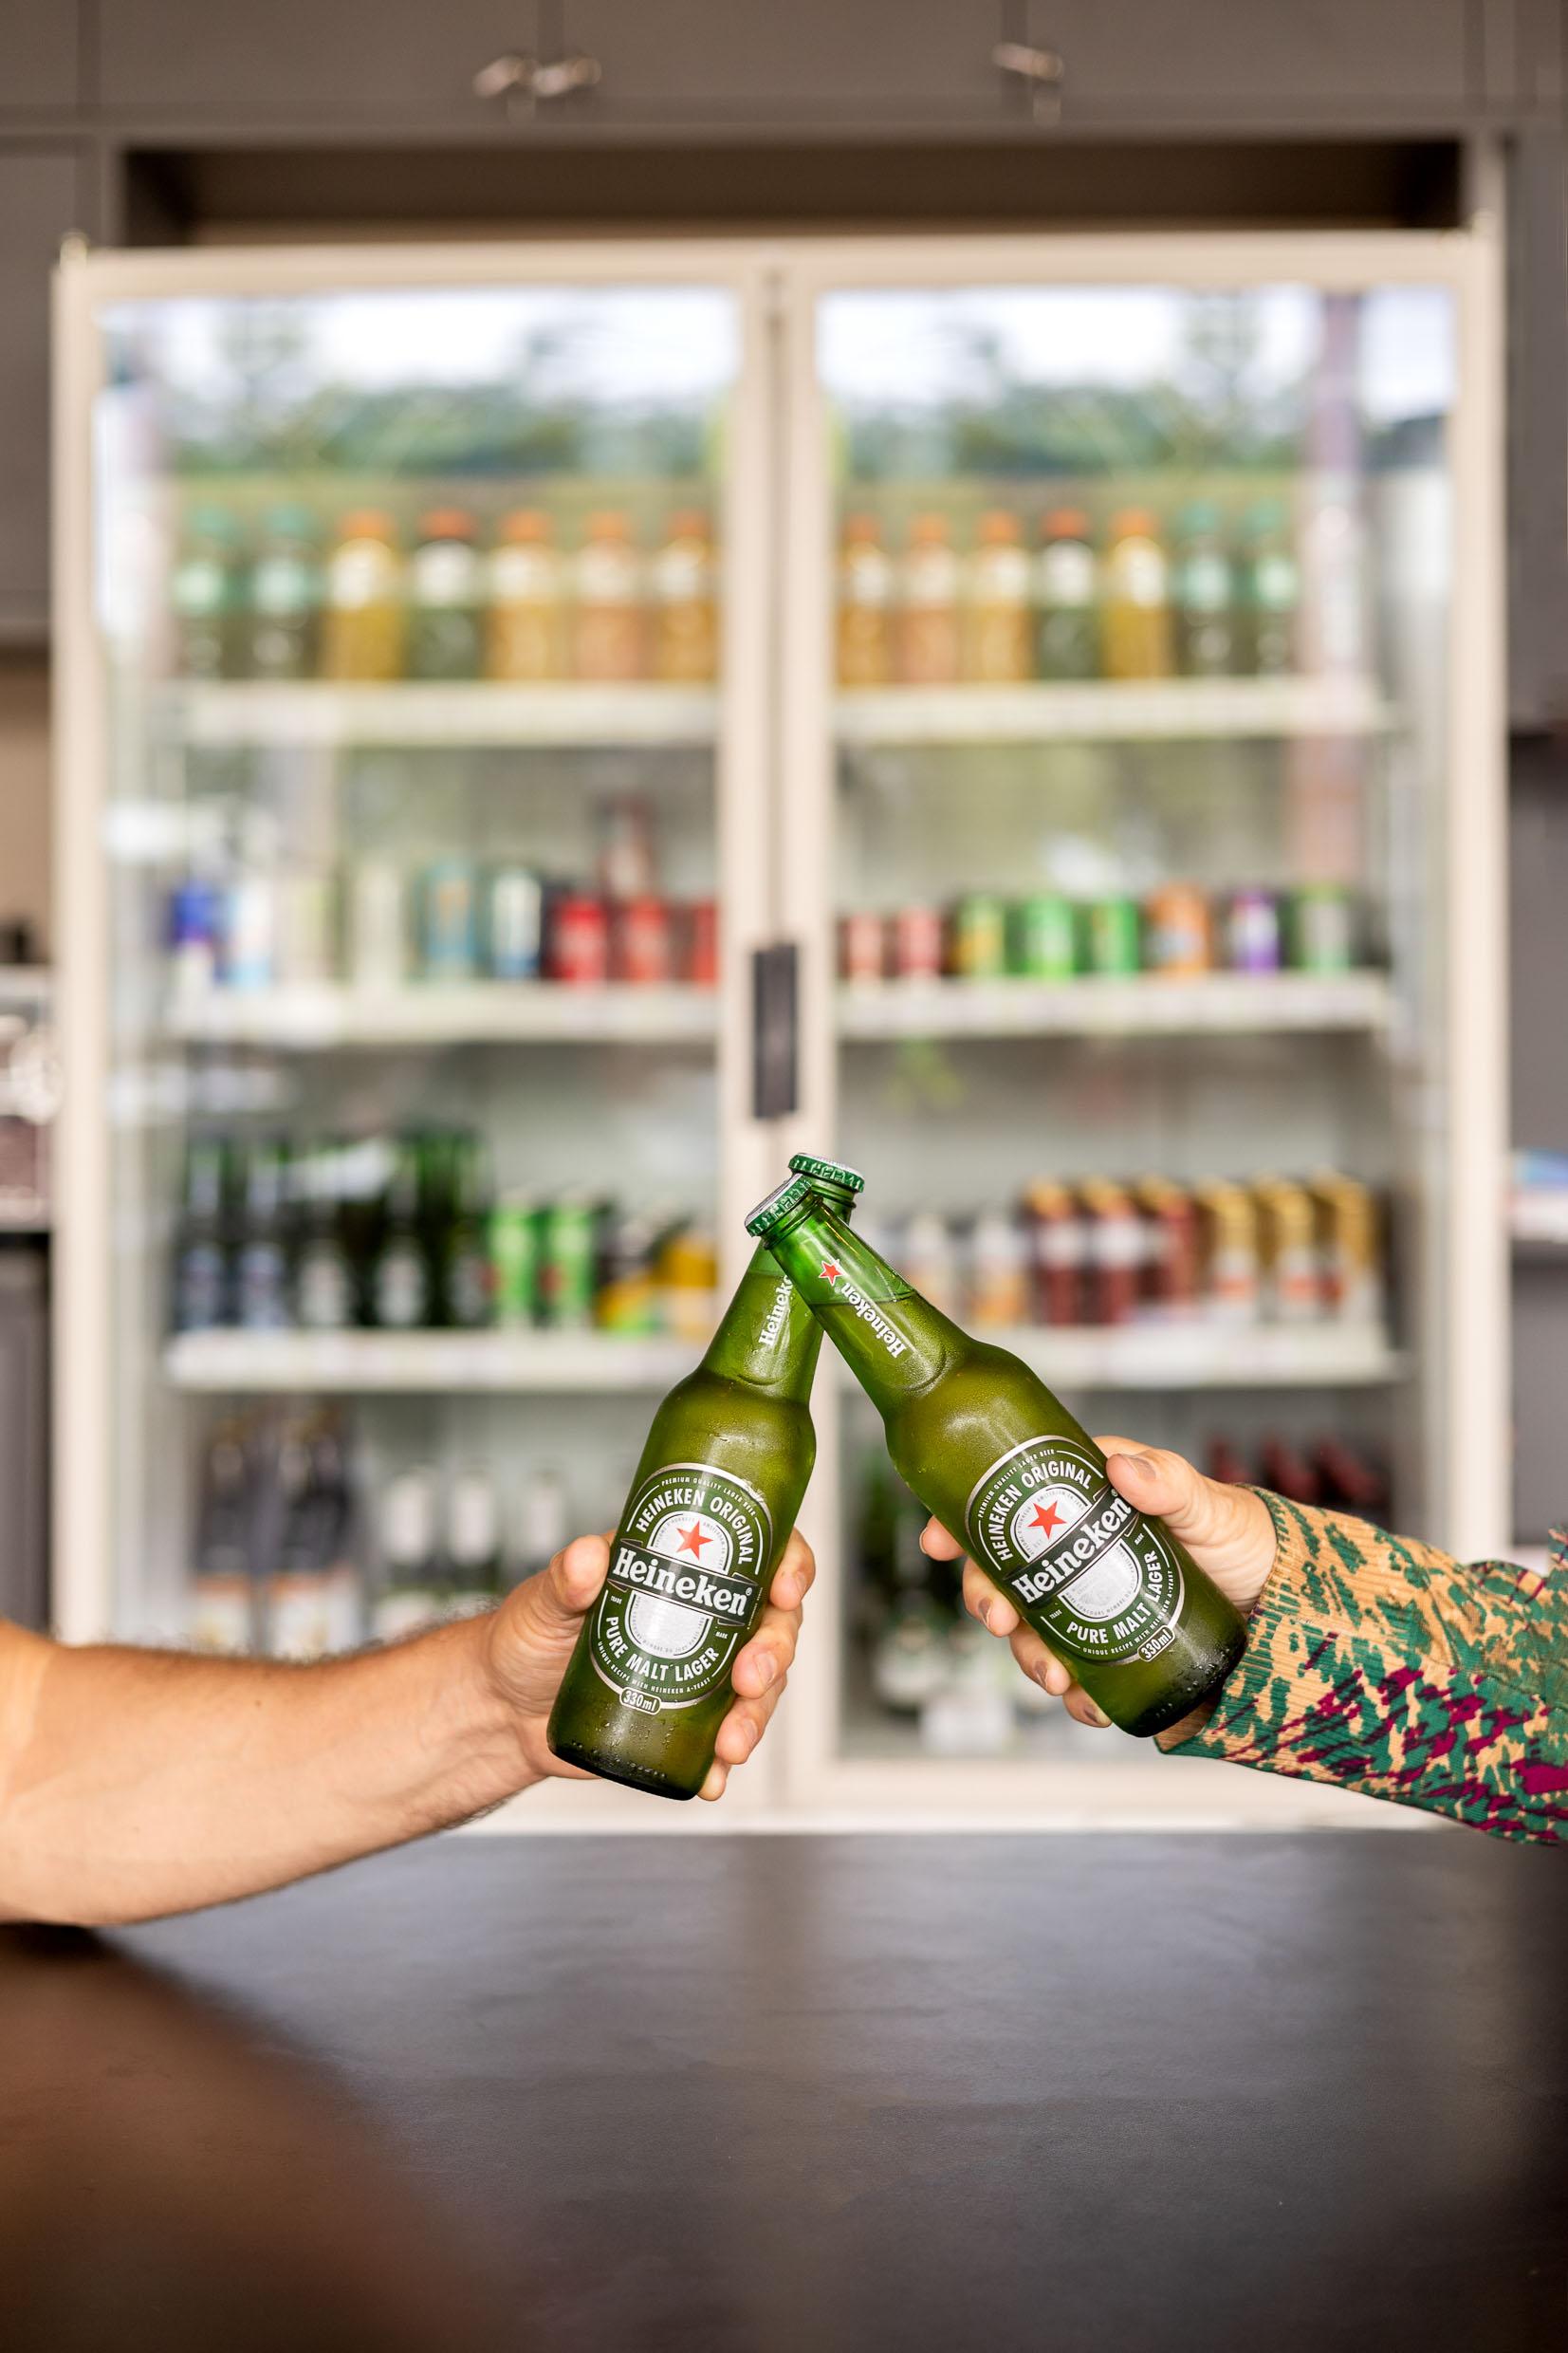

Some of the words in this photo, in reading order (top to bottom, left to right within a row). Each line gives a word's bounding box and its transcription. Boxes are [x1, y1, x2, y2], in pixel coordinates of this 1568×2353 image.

[840, 1282, 907, 1359] Heineken
[661, 1476, 691, 1487] PREMIUM
[692, 1477, 722, 1491] QUALITY
[723, 1487, 744, 1503] LAGER
[977, 1490, 995, 1518] PREMIUM
[993, 1467, 1018, 1490] QUALITY
[1018, 1454, 1038, 1468] LAGER
[987, 1484, 1023, 1561] HEINEKEN
[1021, 1460, 1092, 1490] ORIGINAL
[636, 1488, 706, 1533] HEINEKEN
[710, 1496, 754, 1565] ORIGINAL
[1011, 1496, 1132, 1603] Heineken
[612, 1547, 747, 1617] Heineken
[1066, 1621, 1109, 1644] PURE
[1112, 1602, 1152, 1640] MALT
[1144, 1549, 1163, 1603] LAGER
[605, 1616, 629, 1659] PURE
[625, 1653, 669, 1681] MALT
[674, 1647, 719, 1682] LAGER
[1111, 1640, 1134, 1654] RECIPE
[1134, 1629, 1151, 1643] WITH
[1149, 1600, 1171, 1630] HEINEKEN
[1140, 1628, 1172, 1658] 330ml
[598, 1640, 612, 1665] UNIQUE
[610, 1664, 631, 1681] RECIPE
[632, 1678, 649, 1689] WITH
[651, 1685, 684, 1695] HEINEKEN
[622, 1690, 657, 1712] 330ml
